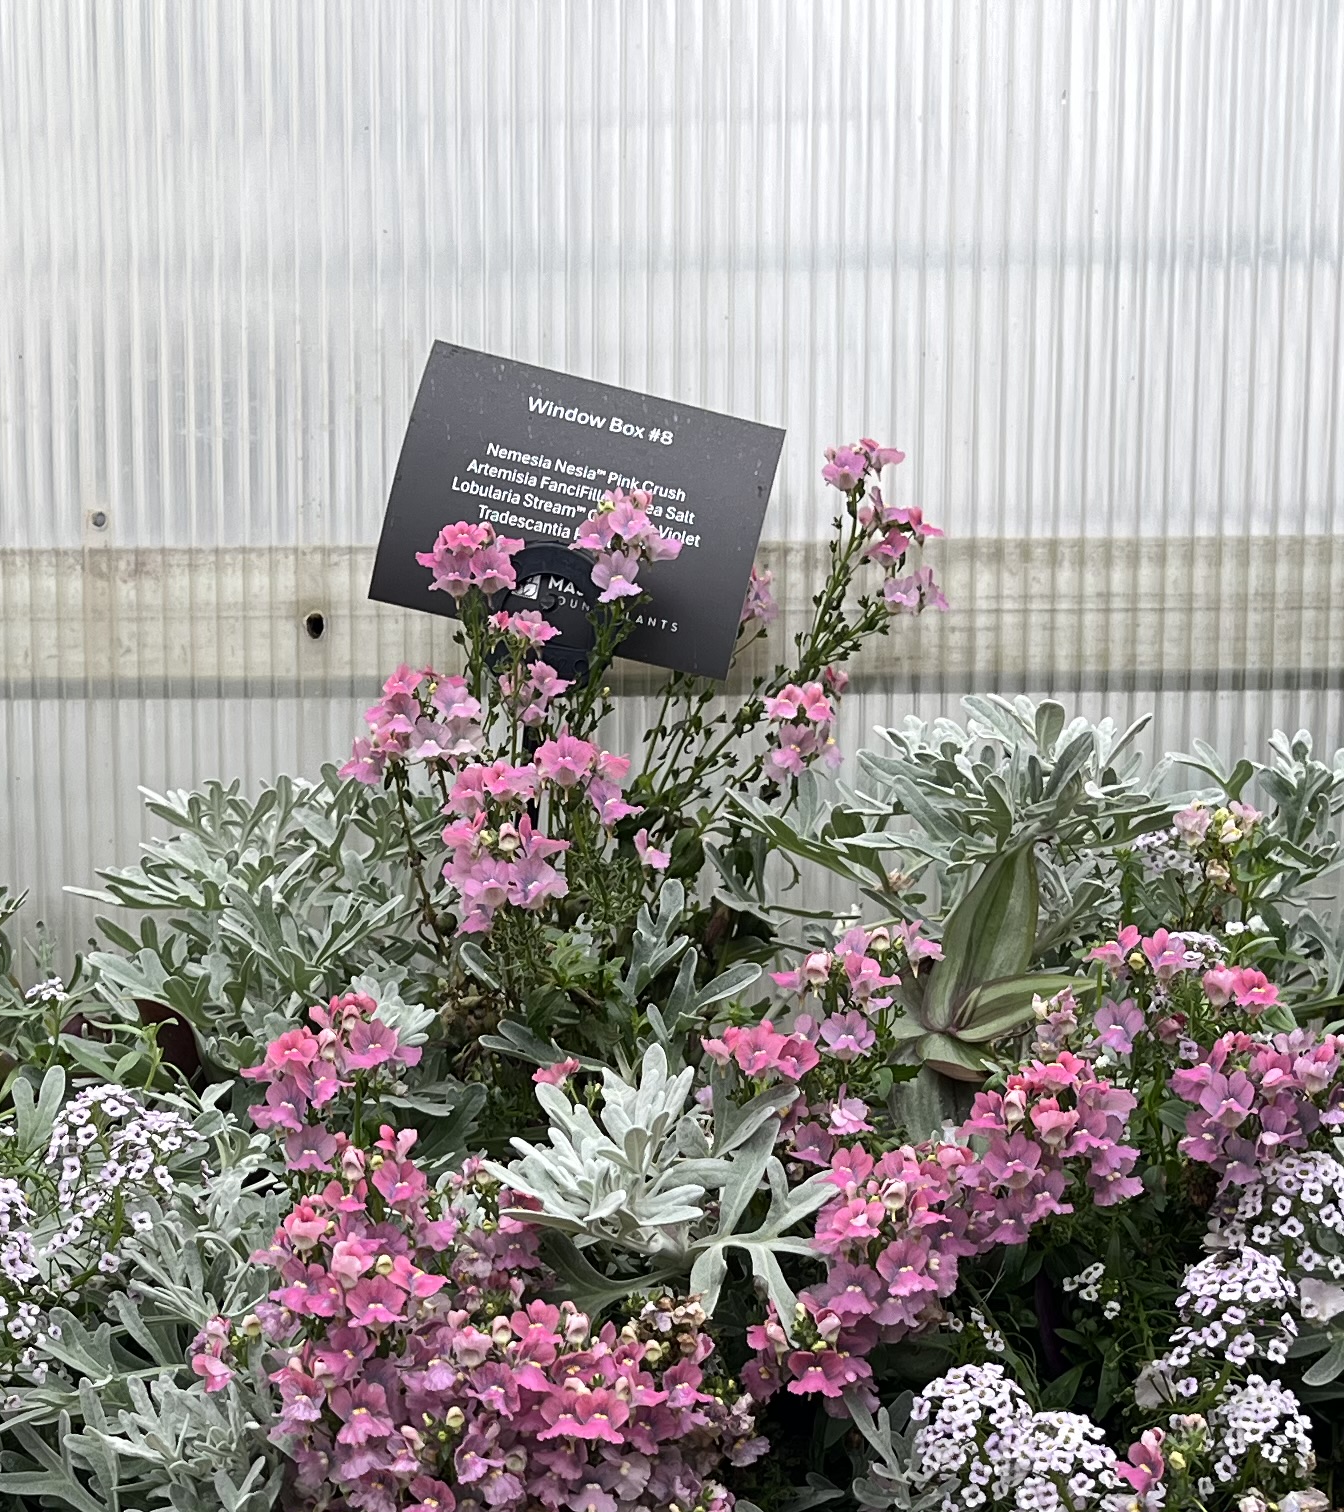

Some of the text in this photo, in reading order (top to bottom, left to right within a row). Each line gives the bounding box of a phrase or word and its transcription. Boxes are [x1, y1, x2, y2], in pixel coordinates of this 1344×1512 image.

[528, 396, 674, 445] Window Box #8
[466, 459, 538, 487] Artemisia
[540, 476, 608, 506] FanciFill
[665, 506, 695, 525] Salt
[486, 442, 552, 470] Nemesia
[607, 471, 640, 490] Pink
[641, 480, 686, 502] Crush
[451, 476, 521, 505] Lobularia
[658, 525, 701, 547] Violet
[478, 504, 571, 539] Tradescantia
[624, 610, 679, 633] LANTS
